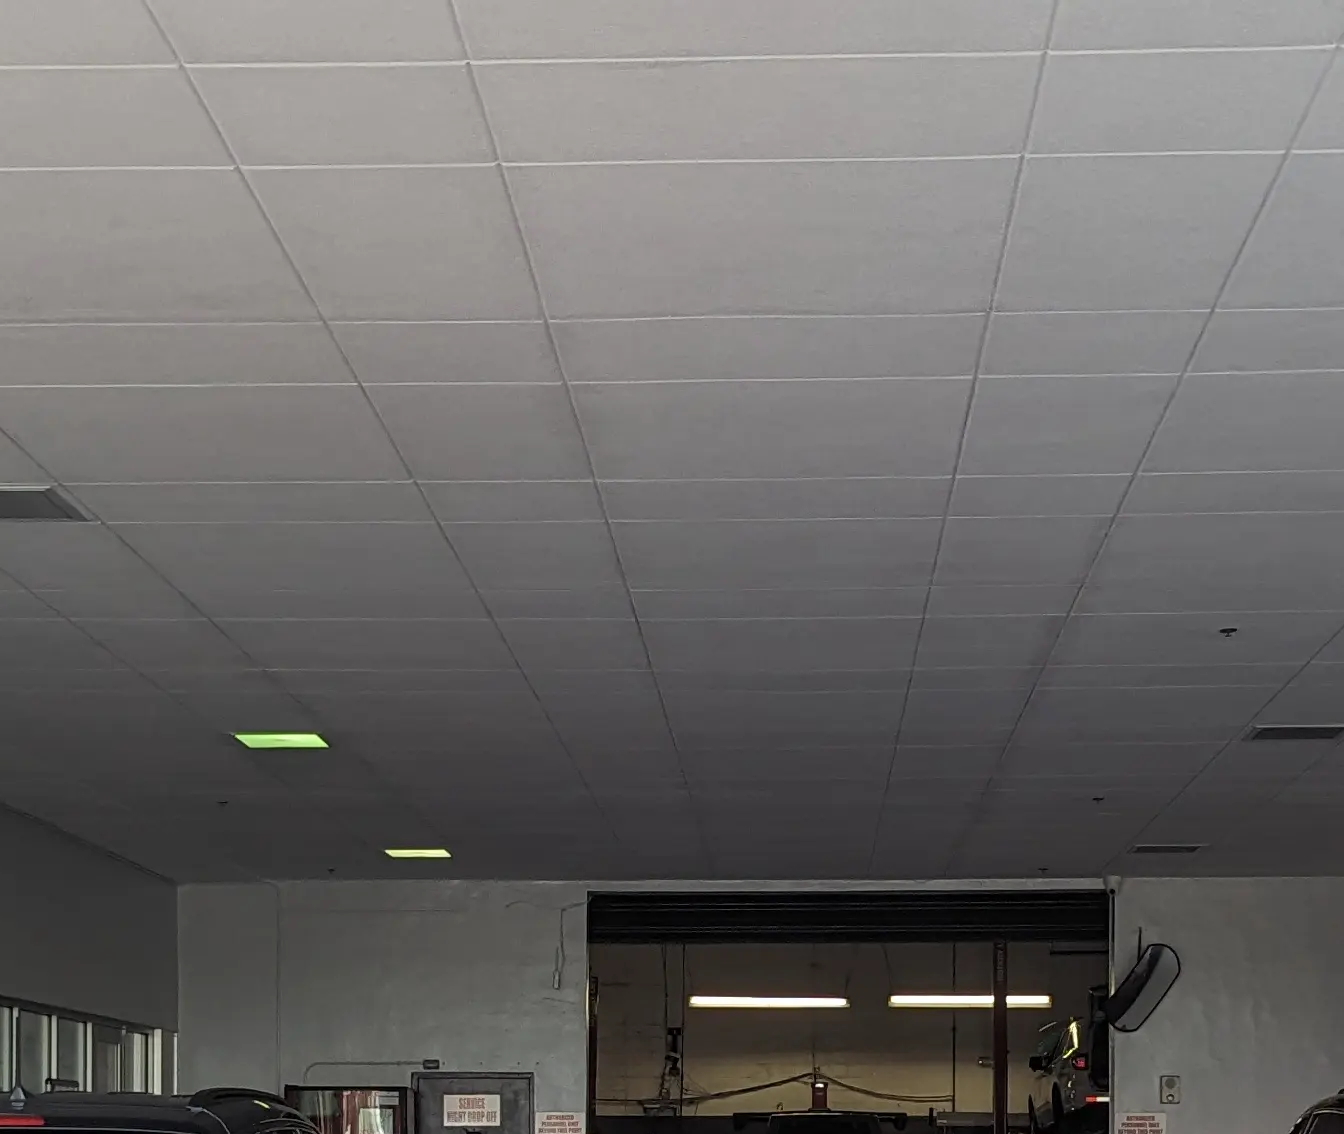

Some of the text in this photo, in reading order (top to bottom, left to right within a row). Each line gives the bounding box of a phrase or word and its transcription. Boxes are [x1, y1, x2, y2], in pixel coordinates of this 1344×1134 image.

[459, 1098, 485, 1109] SERVICE
[447, 1111, 497, 1122] NIGHT DROP OFF
